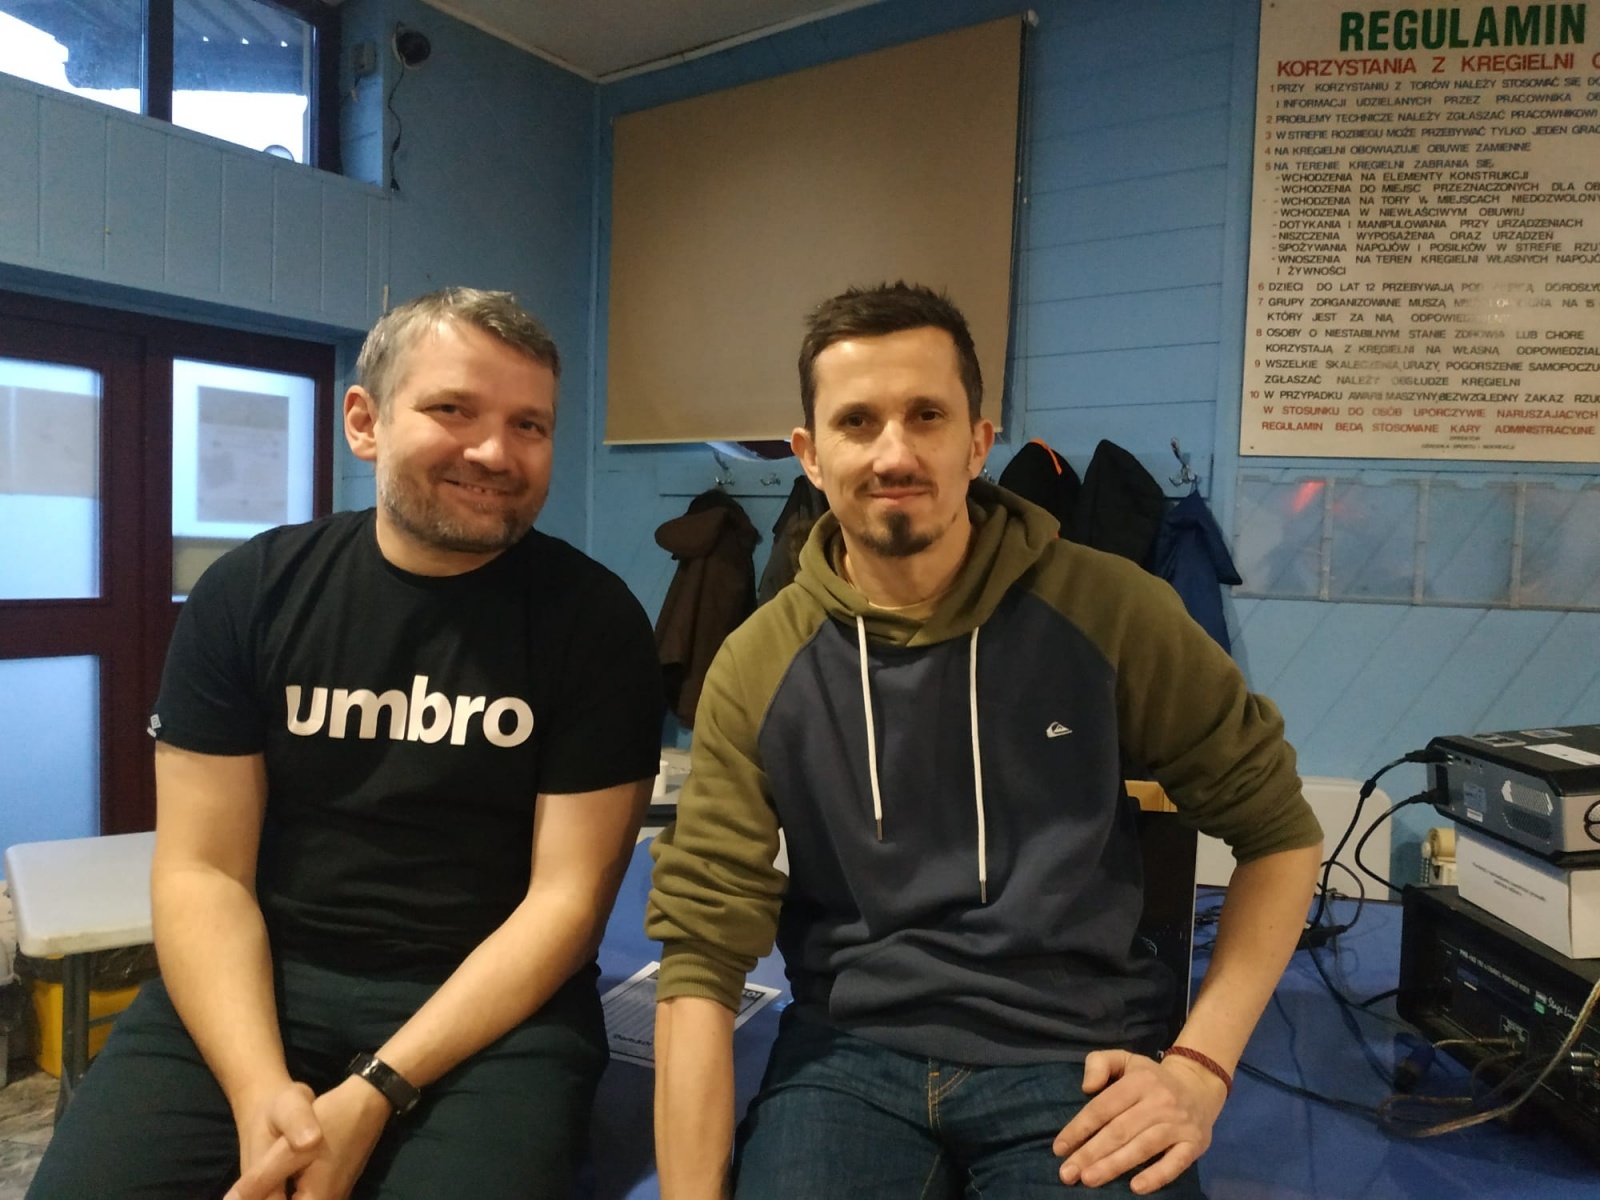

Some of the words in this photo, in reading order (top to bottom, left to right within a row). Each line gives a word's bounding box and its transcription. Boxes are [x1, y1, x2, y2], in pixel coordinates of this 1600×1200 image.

[1340, 3, 1586, 52] REGULAMIN
[1277, 57, 1416, 77] KORZYSTANIA
[1432, 56, 1446, 73] Z
[1461, 52, 1574, 74] KRĘGIELNI
[1277, 83, 1305, 93] PRZY
[1315, 81, 1389, 92] KORZYSTANIU
[1395, 82, 1402, 90] Z
[1410, 79, 1450, 90] TORÓW
[1454, 79, 1496, 90] NALEŻY
[1502, 77, 1559, 88] STOSOWAĆ
[1283, 98, 1346, 108] INFORMACJI
[1356, 97, 1432, 107] UDZIELANYCH
[1444, 96, 1481, 105] PRZEZ
[1496, 93, 1572, 104] PRACOWNIKA
[1266, 115, 1272, 124] 2
[1275, 114, 1331, 124] PROBLEMY
[1336, 113, 1394, 123] TECHNICZE
[1398, 111, 1441, 122] NALEŻY
[1446, 109, 1505, 121] ZGŁASZAĆ
[1511, 108, 1597, 119] PRACOWNIKOWI
[1265, 131, 1271, 140] 3
[1276, 131, 1285, 140] W
[1288, 130, 1328, 140] STREFIE
[1332, 129, 1383, 139] ROZBIEGU
[1387, 127, 1416, 138] MOŻE
[1421, 126, 1486, 137] PRZEBYWAĆ
[1490, 127, 1526, 136] TYLKO
[1532, 125, 1567, 135] JEDEN
[1265, 147, 1271, 155] 4
[1274, 146, 1289, 156] NA
[1292, 145, 1345, 157] KRĘGIELNI
[1350, 144, 1419, 155] OBOWIĄZUJE
[1427, 143, 1470, 153] OBUWIE
[1475, 142, 1532, 152] ZAMIENNE
[1265, 161, 1271, 170] 5
[1274, 161, 1288, 170] NA
[1295, 160, 1340, 170] TERENIE
[1349, 159, 1404, 171] KRĘGIELNI
[1414, 159, 1469, 168] ZABRANIA
[1281, 172, 1352, 182] WCHODZENIA
[1360, 172, 1375, 181] NA
[1383, 171, 1443, 181] ELEMENTY
[1449, 171, 1529, 180] KONSTRUKCJI
[1281, 184, 1351, 194] WCHODZENIA
[1360, 184, 1375, 193] DO
[1382, 183, 1421, 193] MIEJSC
[1433, 182, 1539, 192] PRZEZNACZONYCH
[1551, 182, 1575, 191] DLA
[1280, 196, 1350, 206] WCHODZENIA
[1359, 196, 1374, 205] NA
[1381, 195, 1410, 205] TORY
[1437, 195, 1500, 204] MIEJSCACH
[1280, 208, 1350, 217] WCHODZENIA
[1359, 208, 1370, 216] W
[1379, 206, 1467, 216] NIEWŁAŚCIWYM
[1479, 207, 1524, 216] OBUWIU
[1279, 220, 1341, 229] DOTYKANIA
[1357, 219, 1447, 229] MANIPULOWANIA
[1460, 219, 1489, 228] PRZY
[1497, 218, 1583, 229] URZĄDZENIACH
[1278, 231, 1340, 240] NISZCZENIA
[1356, 230, 1435, 240] WYPOSAŻENIA
[1450, 231, 1482, 240] ORAZ
[1278, 242, 1347, 252] SPOŻYWANIA
[1356, 242, 1411, 252] NAPOJÓW
[1429, 242, 1486, 252] POSIŁKÓW
[1496, 243, 1507, 251] W
[1515, 242, 1562, 251] STREFIE
[1278, 255, 1340, 264] WNOSZENIA
[1355, 255, 1371, 263] NA
[1376, 254, 1412, 263] TEREN
[1421, 254, 1478, 264] KRĘGIELNI
[1486, 255, 1548, 263] WŁASNYCH
[1288, 265, 1346, 276] ŻYWNOŚCI
[1258, 283, 1264, 291] 6
[1268, 282, 1303, 291] DZIECI
[1316, 282, 1332, 291] DO
[1339, 282, 1360, 291] LAT
[1365, 283, 1375, 291] 12
[1382, 283, 1454, 293] PRZEBYWAJĄ
[1258, 298, 1263, 306] 7
[1268, 298, 1305, 307] GRUPY
[1310, 298, 1401, 307] ZORGANIZOWANE
[1409, 298, 1447, 309] MUSZĄ
[1562, 299, 1577, 307] NA
[1267, 311, 1303, 321] KTÓRY
[1312, 313, 1337, 322] JEST
[1349, 313, 1364, 322] ZA
[1375, 313, 1393, 323] NIĄ
[1256, 329, 1262, 337] 8
[1266, 328, 1302, 337] OSOBY
[1309, 329, 1317, 337] O
[1324, 329, 1400, 338] NIESTABILNYM
[1408, 329, 1446, 339] STANIE
[1516, 330, 1537, 339] LUB
[1545, 330, 1585, 340] CHORE
[1266, 344, 1333, 354] KORZYSTAJĄ
[1344, 345, 1352, 353] Z
[1358, 345, 1415, 355] KRĘGIELNI
[1426, 345, 1441, 354] NA
[1254, 360, 1260, 368] 9
[1265, 360, 1318, 369] WSZELKIE
[1446, 361, 1523, 371] POGORSZENIE
[1264, 375, 1322, 384] ZGŁASZAĆ
[1461, 377, 1521, 387] KRĘGIELNI
[1264, 391, 1274, 399] W
[1279, 391, 1343, 400] PRZYPADKU
[1524, 393, 1564, 403] ZAKAZ
[1263, 406, 1274, 414] W
[1282, 406, 1340, 416] STOSUNKU
[1348, 407, 1364, 416] DO
[1372, 405, 1402, 416] OSÓB
[1413, 407, 1486, 417] UPORCZYWIE
[1497, 409, 1599, 420] NARUSZAJĄCYCH
[1261, 421, 1323, 431] REGULAMIN
[1372, 423, 1439, 433] STOSOWANE
[1450, 424, 1481, 433] KARY
[1495, 425, 1595, 435] ADMINISTRACYJNE
[285, 674, 534, 748] umbro
